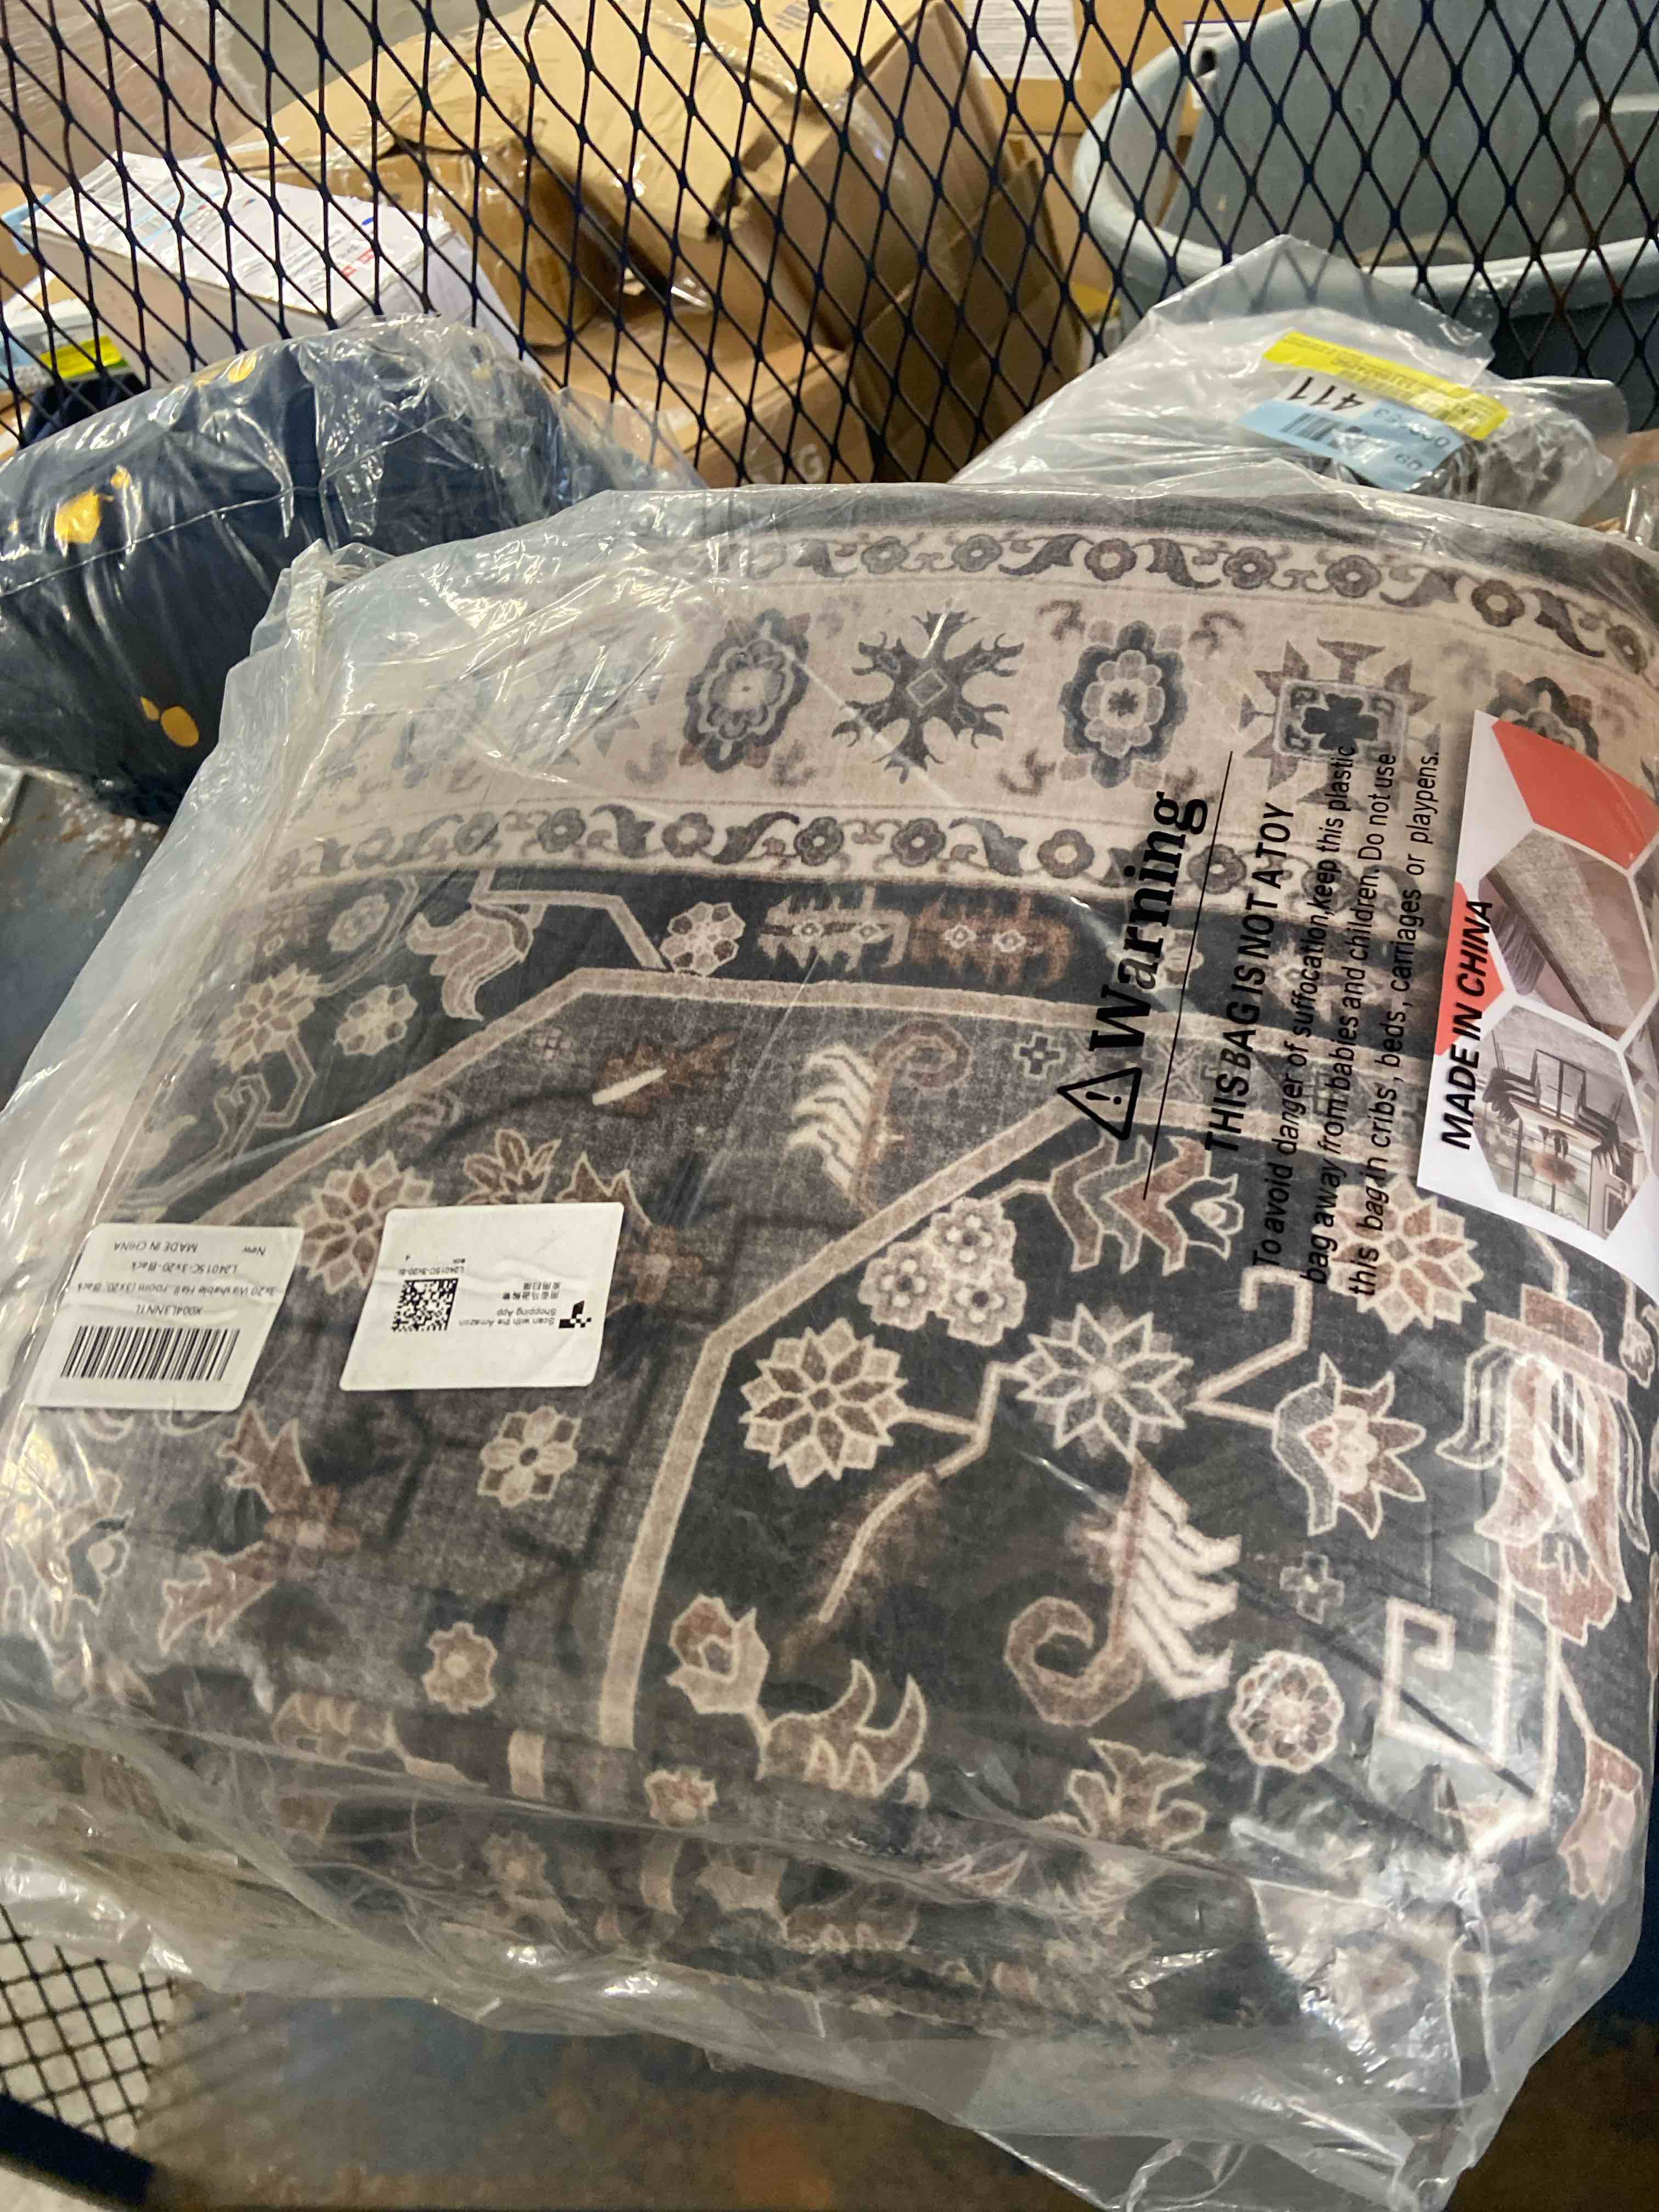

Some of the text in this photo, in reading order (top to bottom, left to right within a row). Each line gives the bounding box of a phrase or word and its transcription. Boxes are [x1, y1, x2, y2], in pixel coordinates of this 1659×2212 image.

[1286, 376, 1363, 411] 411
[1325, 746, 1355, 811] plastic
[1406, 752, 1438, 844] playpens.
[1316, 819, 1343, 853] this
[1406, 854, 1425, 876] or
[1088, 792, 1206, 1051] Warning
[1390, 889, 1423, 992] carriages
[1205, 803, 1293, 1152] THIS BAG IS NOT A TOY
[1300, 754, 1396, 1284] bag away from babies and children. Do not use
[1441, 900, 1492, 1150] MADE IN CHINA
[1284, 1041, 1308, 1066] of
[1273, 1074, 1305, 1154] danger
[1360, 1158, 1387, 1181] in
[1266, 1162, 1293, 1234] avoid
[1356, 1186, 1388, 1231] bag
[114, 1242, 198, 1253] MADE IN CHINA
[242, 1246, 266, 1255] New
[1252, 1239, 1279, 1266] To
[78, 1283, 101, 1293] Black
[199, 1286, 248, 1296] Washable
[1348, 1246, 1378, 1296] this
[516, 1308, 556, 1317] Shopping
